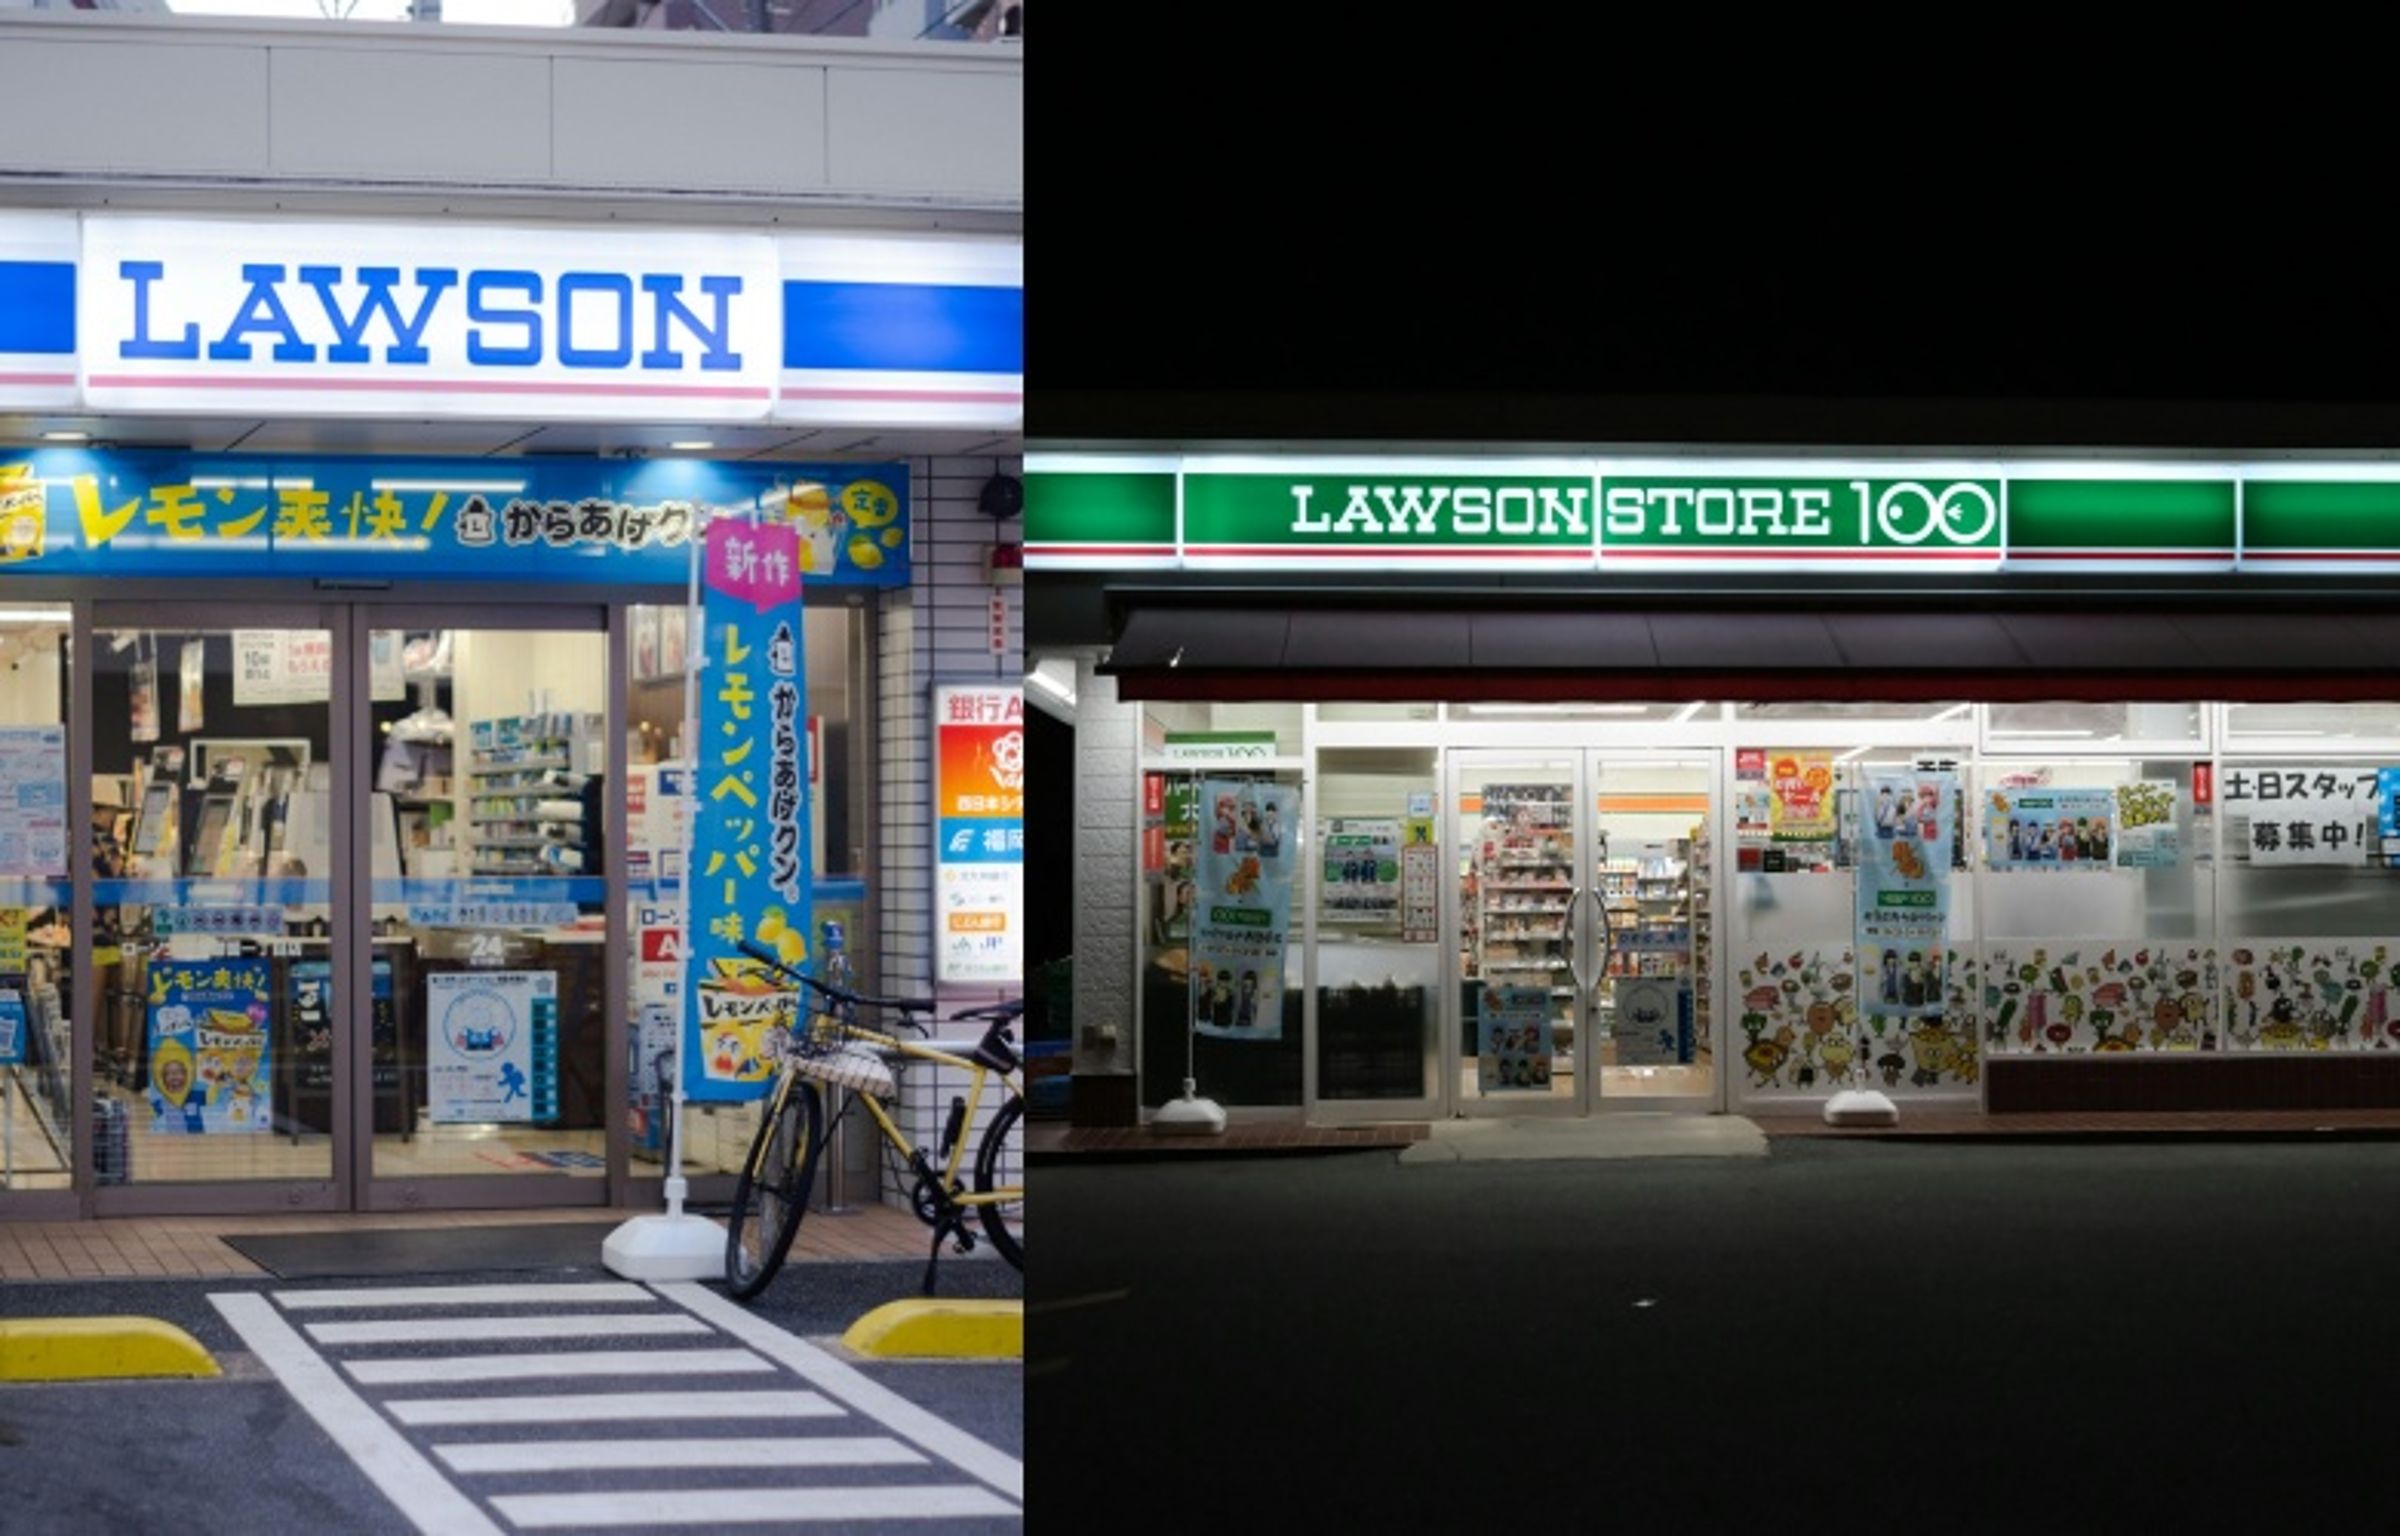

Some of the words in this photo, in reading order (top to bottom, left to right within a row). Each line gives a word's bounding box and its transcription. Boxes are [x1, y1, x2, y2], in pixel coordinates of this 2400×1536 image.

[119, 260, 742, 370] LAWSON
[506, 501, 700, 547] からあげク
[1290, 485, 1590, 535] LAWSON
[1606, 487, 1831, 536] STORE
[1849, 481, 1997, 545] 100
[725, 537, 790, 587] 新作
[704, 623, 760, 946] レモンペッパー味
[2252, 820, 2365, 852] 募集中!
[471, 934, 504, 957] 24
